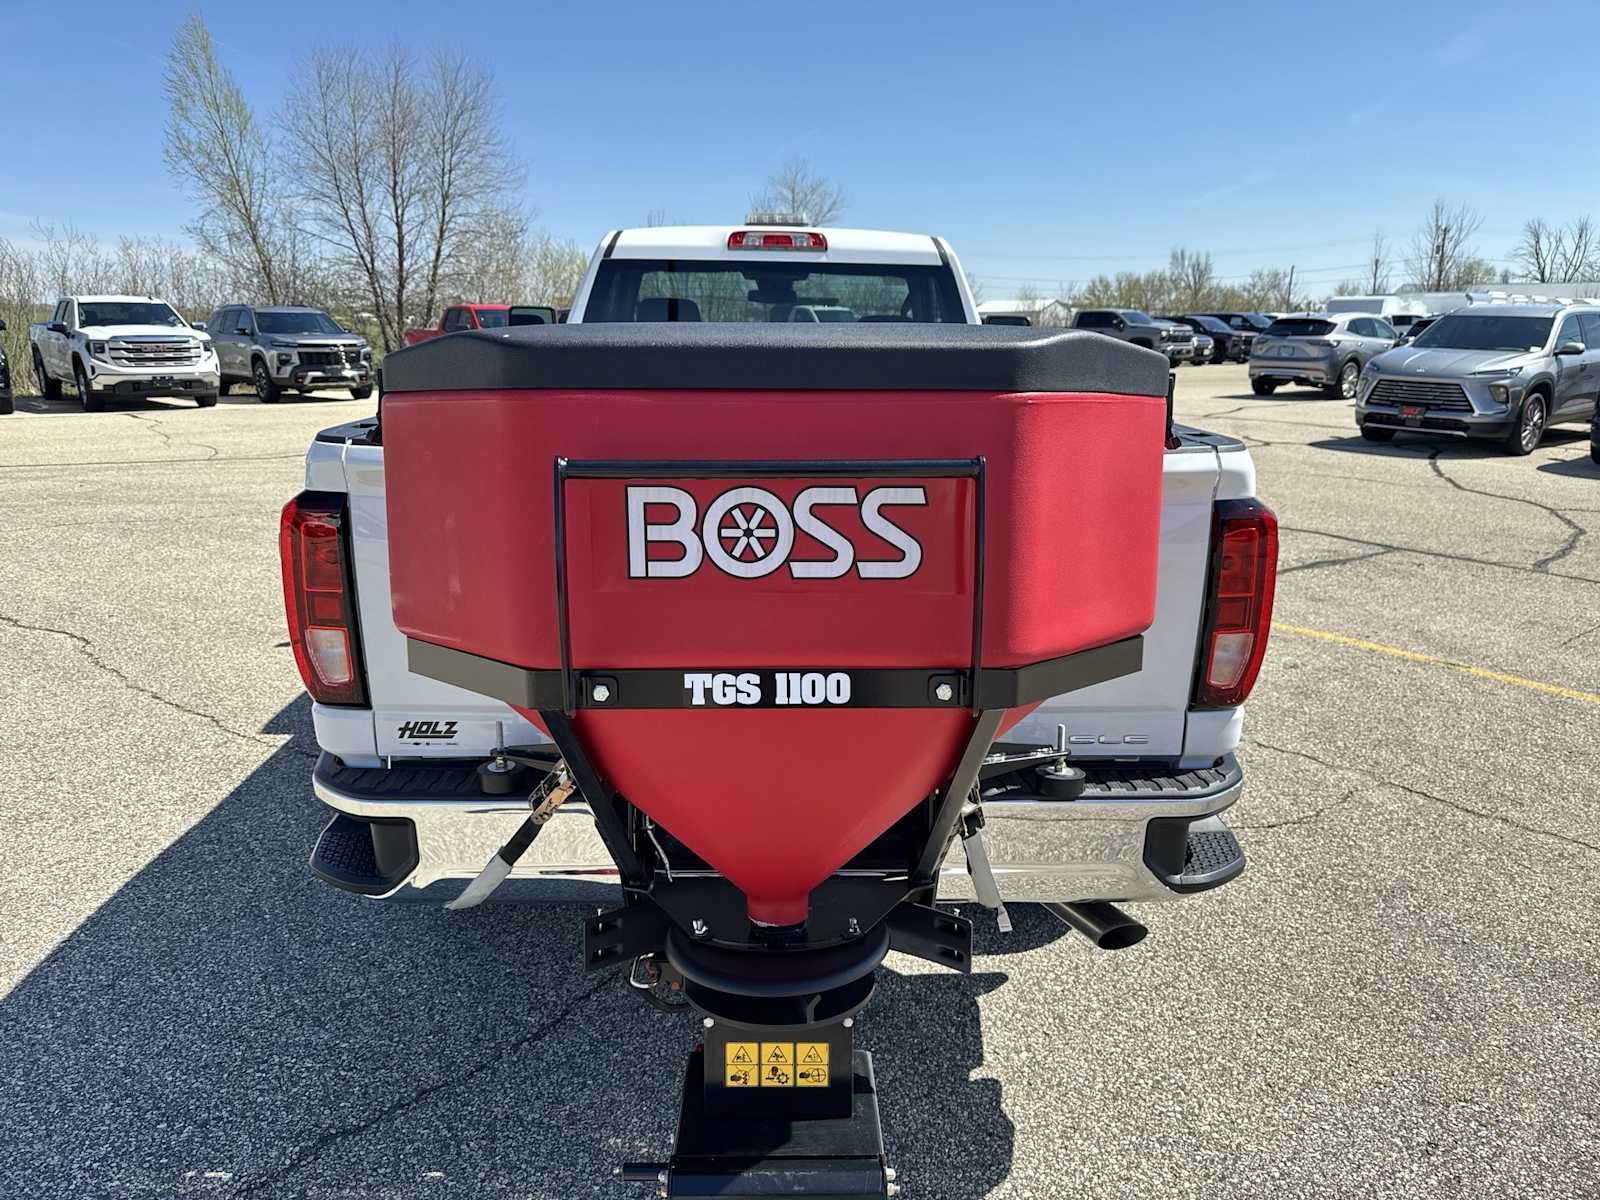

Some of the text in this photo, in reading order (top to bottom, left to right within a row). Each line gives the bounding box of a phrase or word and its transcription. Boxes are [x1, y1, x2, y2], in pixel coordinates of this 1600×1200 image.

[625, 485, 928, 579] BOSS
[684, 672, 851, 705] TGS 1100
[398, 721, 458, 739] HOLZ
[1069, 734, 1149, 744] SLE
